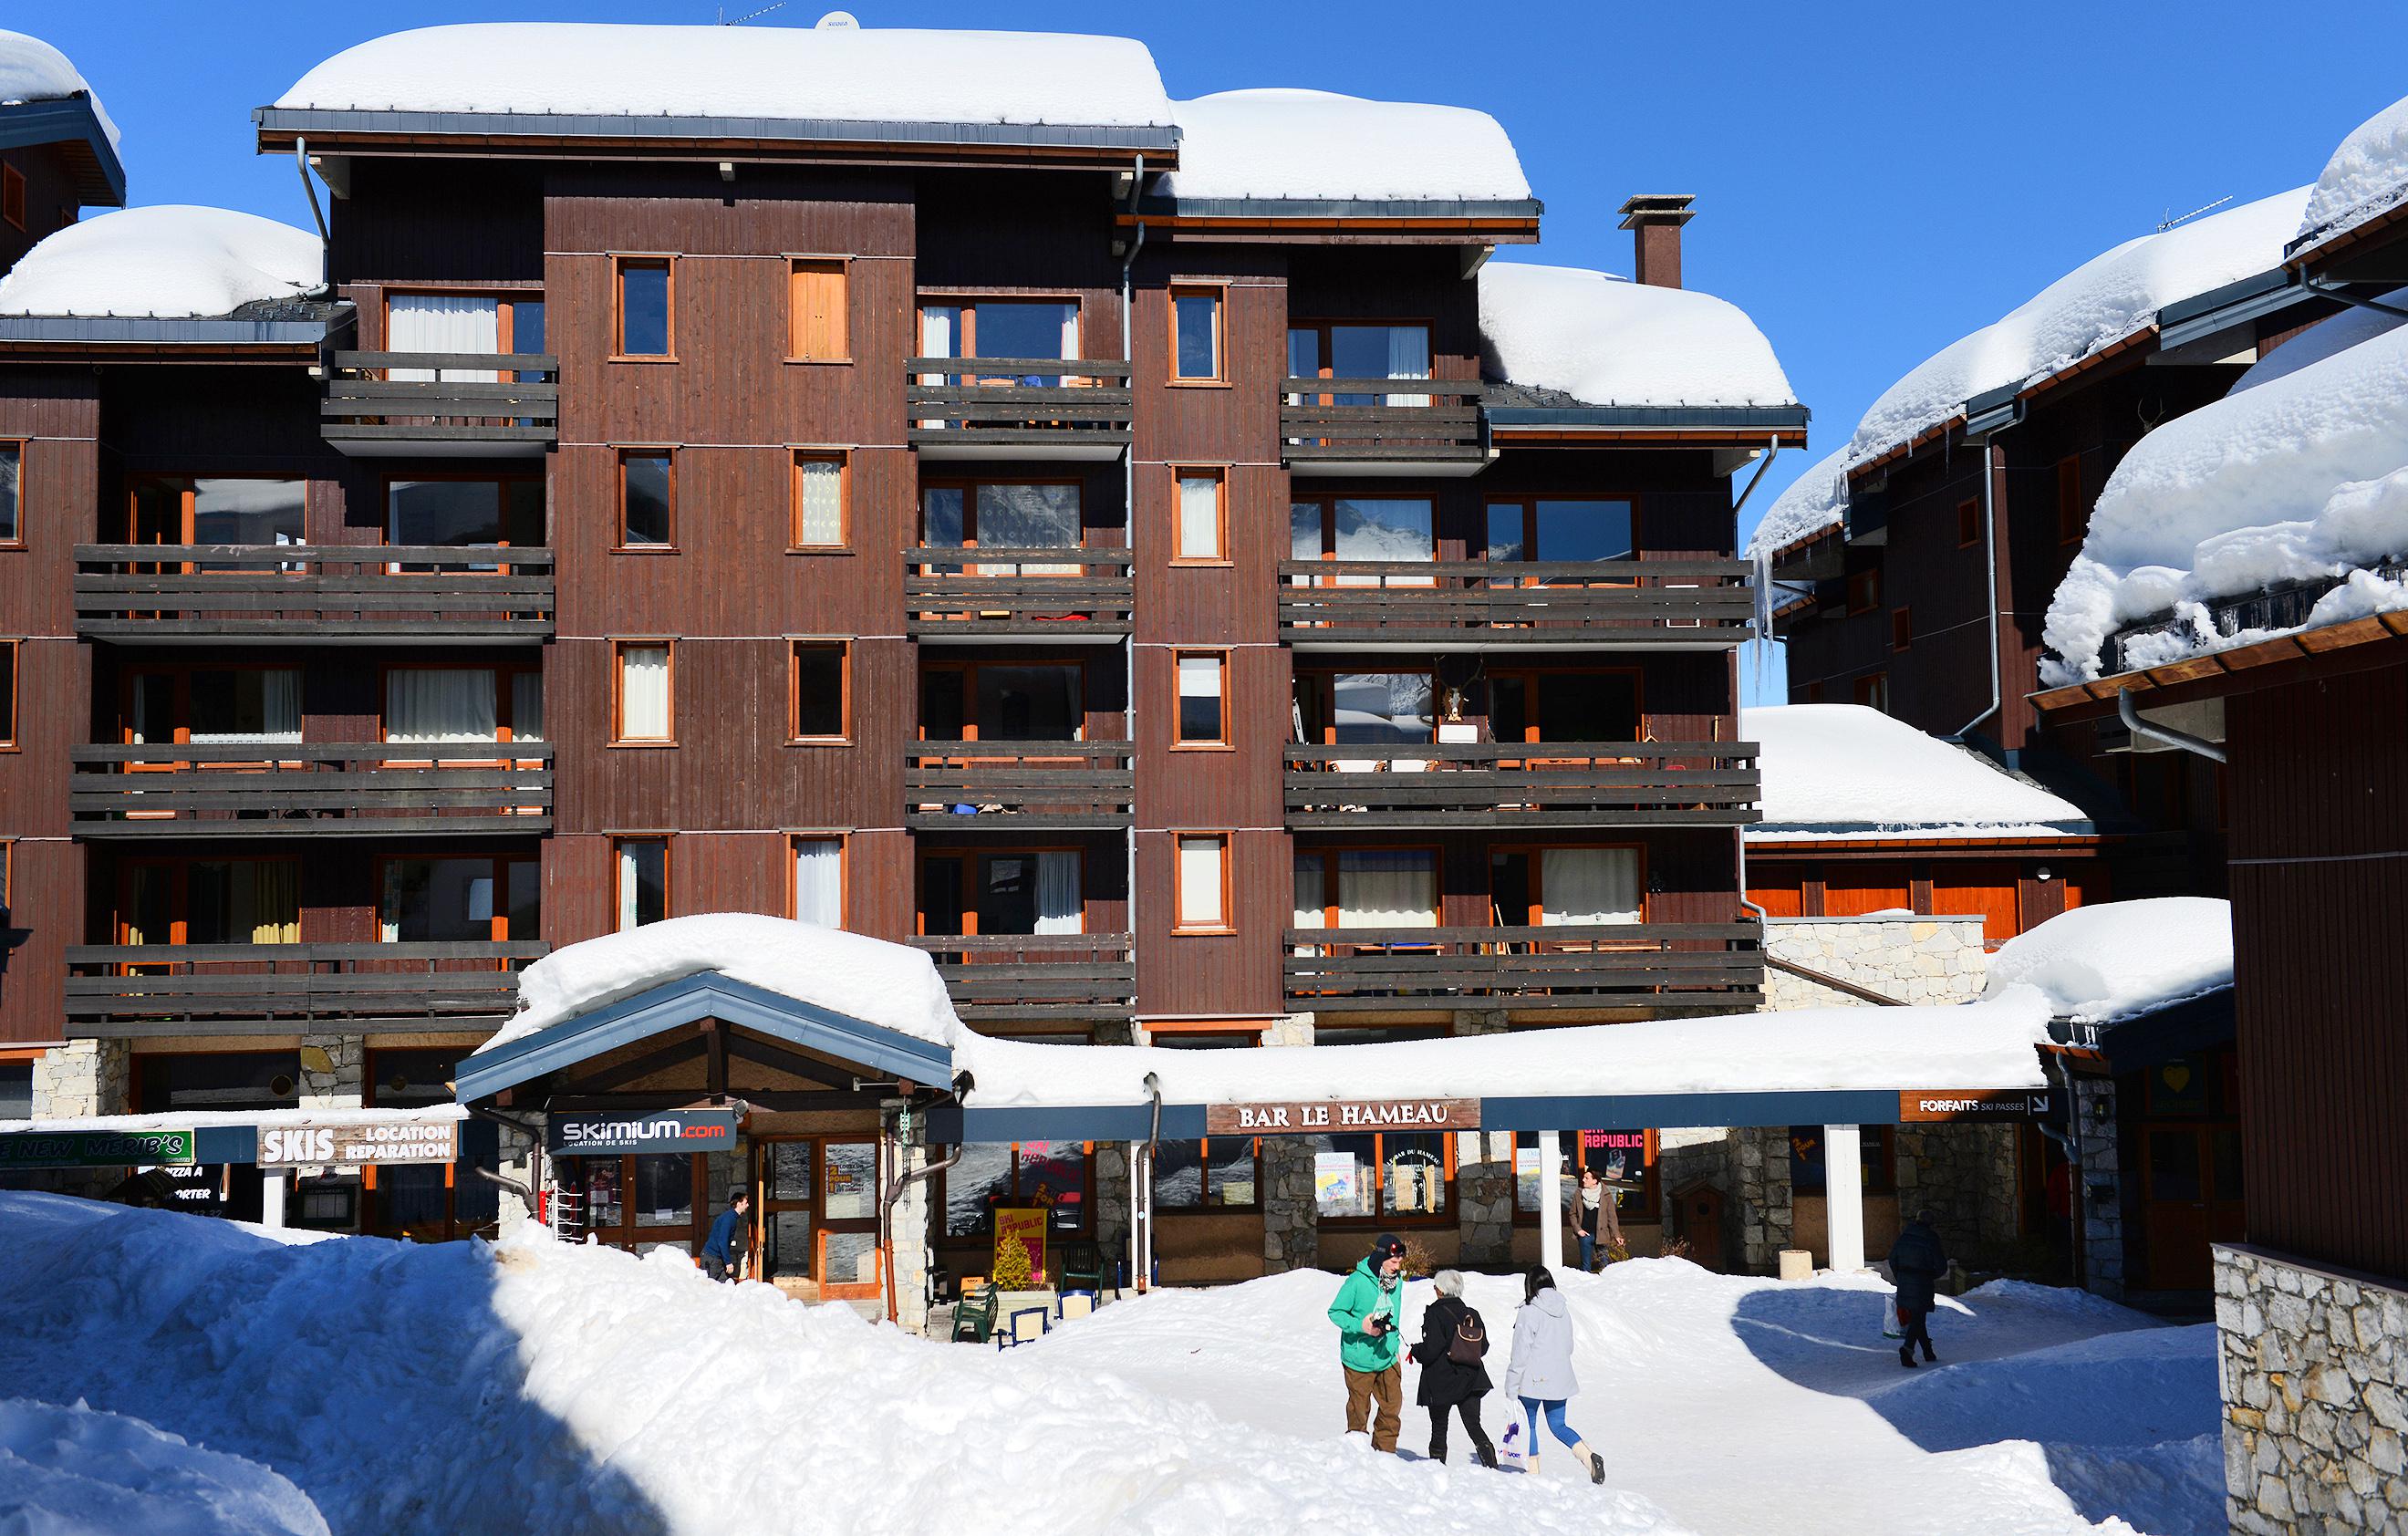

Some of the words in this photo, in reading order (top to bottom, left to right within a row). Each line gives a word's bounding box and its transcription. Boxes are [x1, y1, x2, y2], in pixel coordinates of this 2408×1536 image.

[1919, 1099, 1978, 1112] FORFAITS
[1980, 1103, 1994, 1111] SKI
[1995, 1102, 2025, 1111] PASSES
[1239, 1106, 1291, 1128] BAR
[1301, 1105, 1330, 1126] LE
[1340, 1103, 1449, 1126] HAMEAU
[365, 1126, 452, 1142] LOCATION
[17, 1138, 74, 1158] NEW
[264, 1128, 335, 1163] SKIS
[345, 1142, 452, 1160] REPARATION
[1394, 1150, 1406, 1159] BAR
[1417, 1149, 1441, 1165] HAMEAU
[165, 1167, 192, 1178] IZZA
